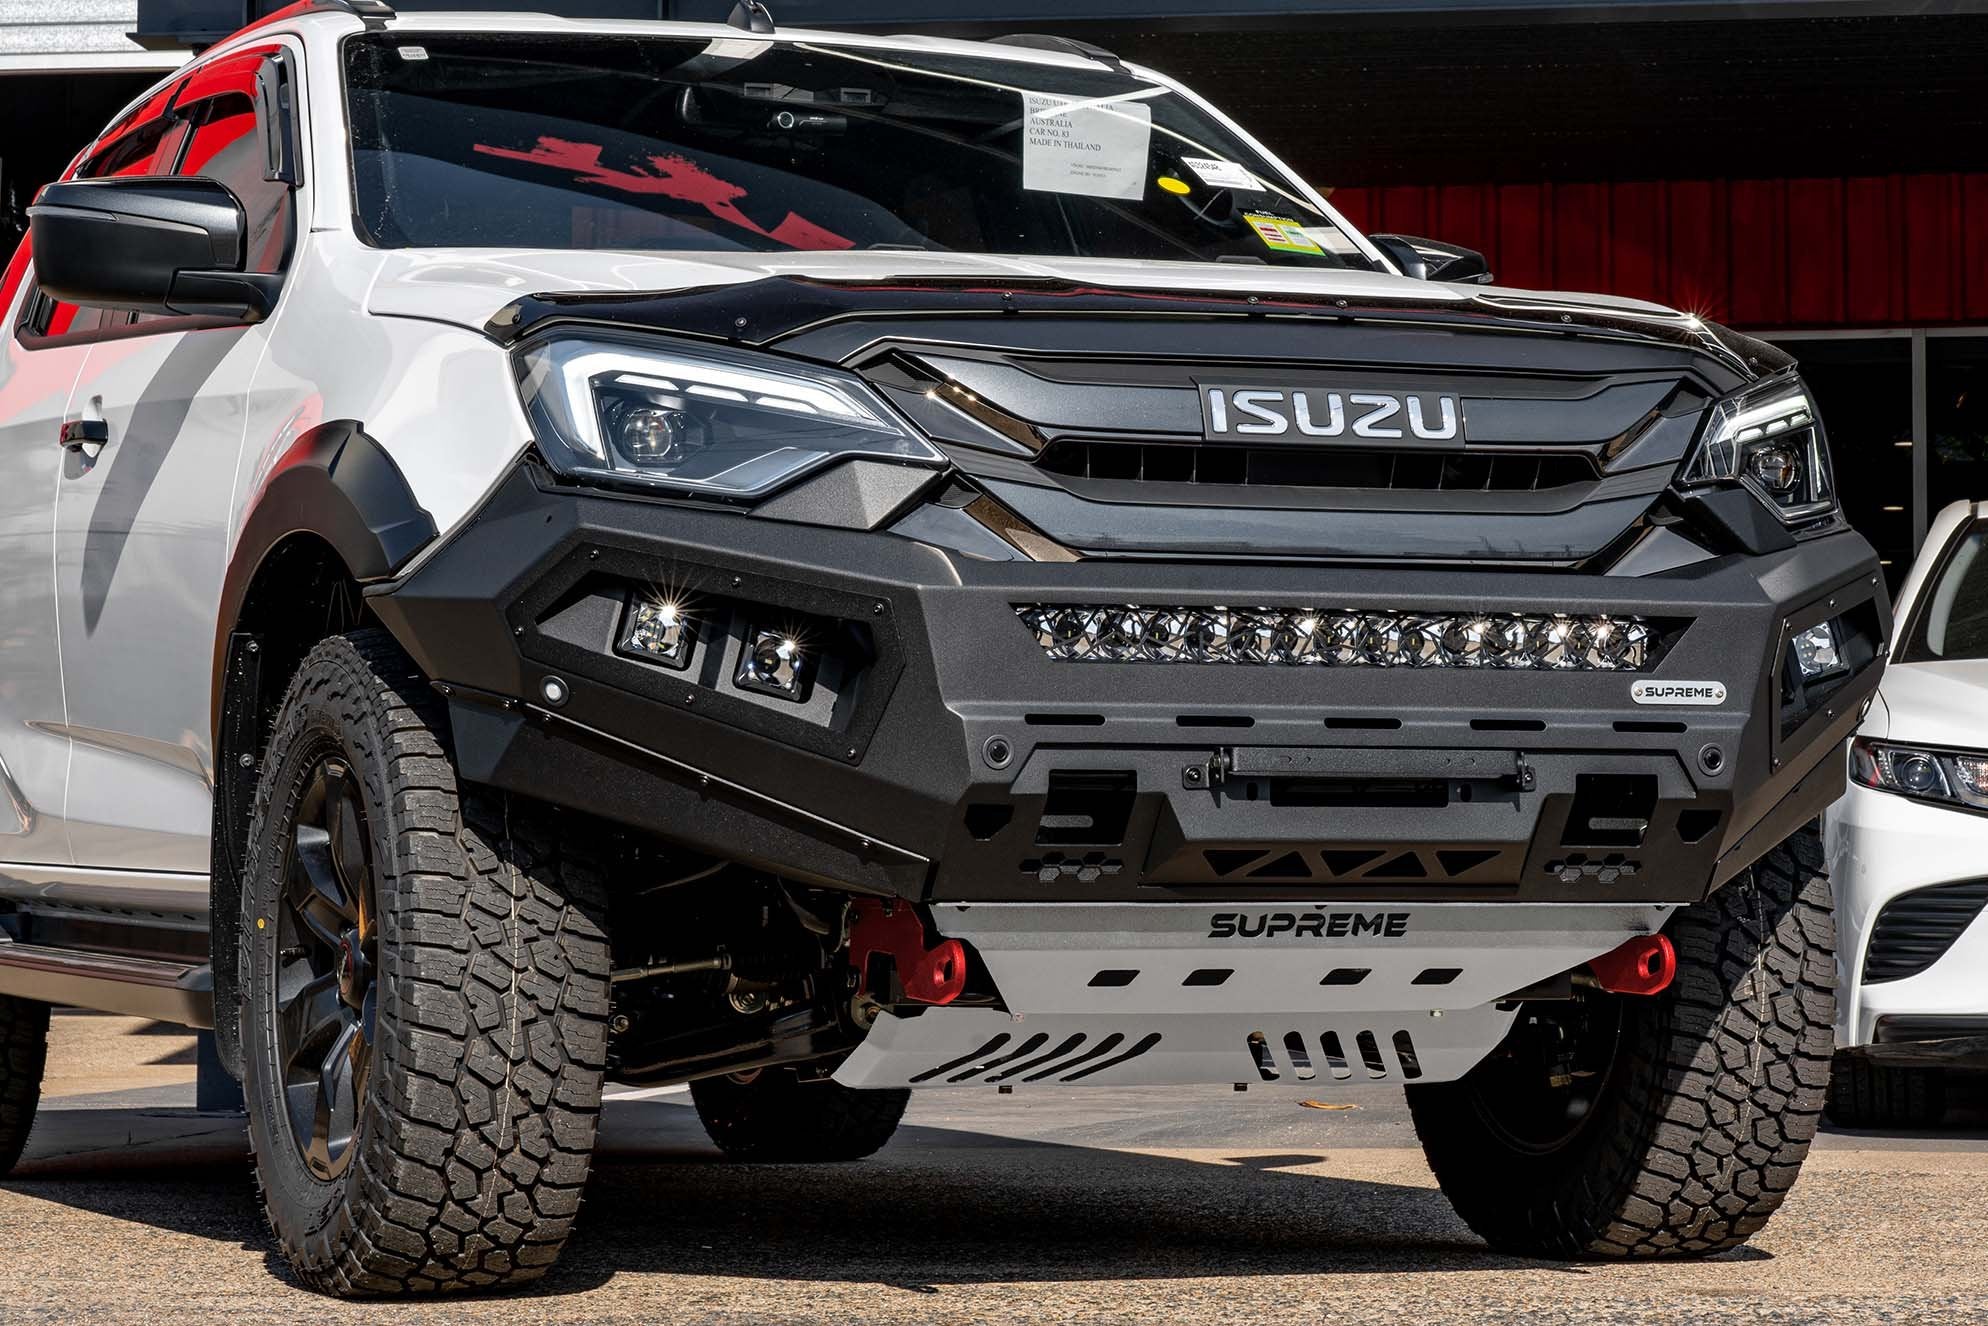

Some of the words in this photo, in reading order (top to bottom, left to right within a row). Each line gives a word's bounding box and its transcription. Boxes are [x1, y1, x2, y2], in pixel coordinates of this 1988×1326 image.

[1029, 97, 1052, 105] ISUZU
[1030, 118, 1073, 128] AUSTRALIA
[1029, 128, 1045, 136] CAR
[1047, 129, 1060, 138] NO.
[1061, 130, 1070, 138] 83
[1029, 138, 1053, 147] MADE
[1053, 139, 1062, 147] IN
[1064, 140, 1102, 151] THAILAND
[1208, 389, 1457, 439] ISUZU
[1645, 687, 1713, 698] SUPREME
[1208, 913, 1411, 938] SUPREME
